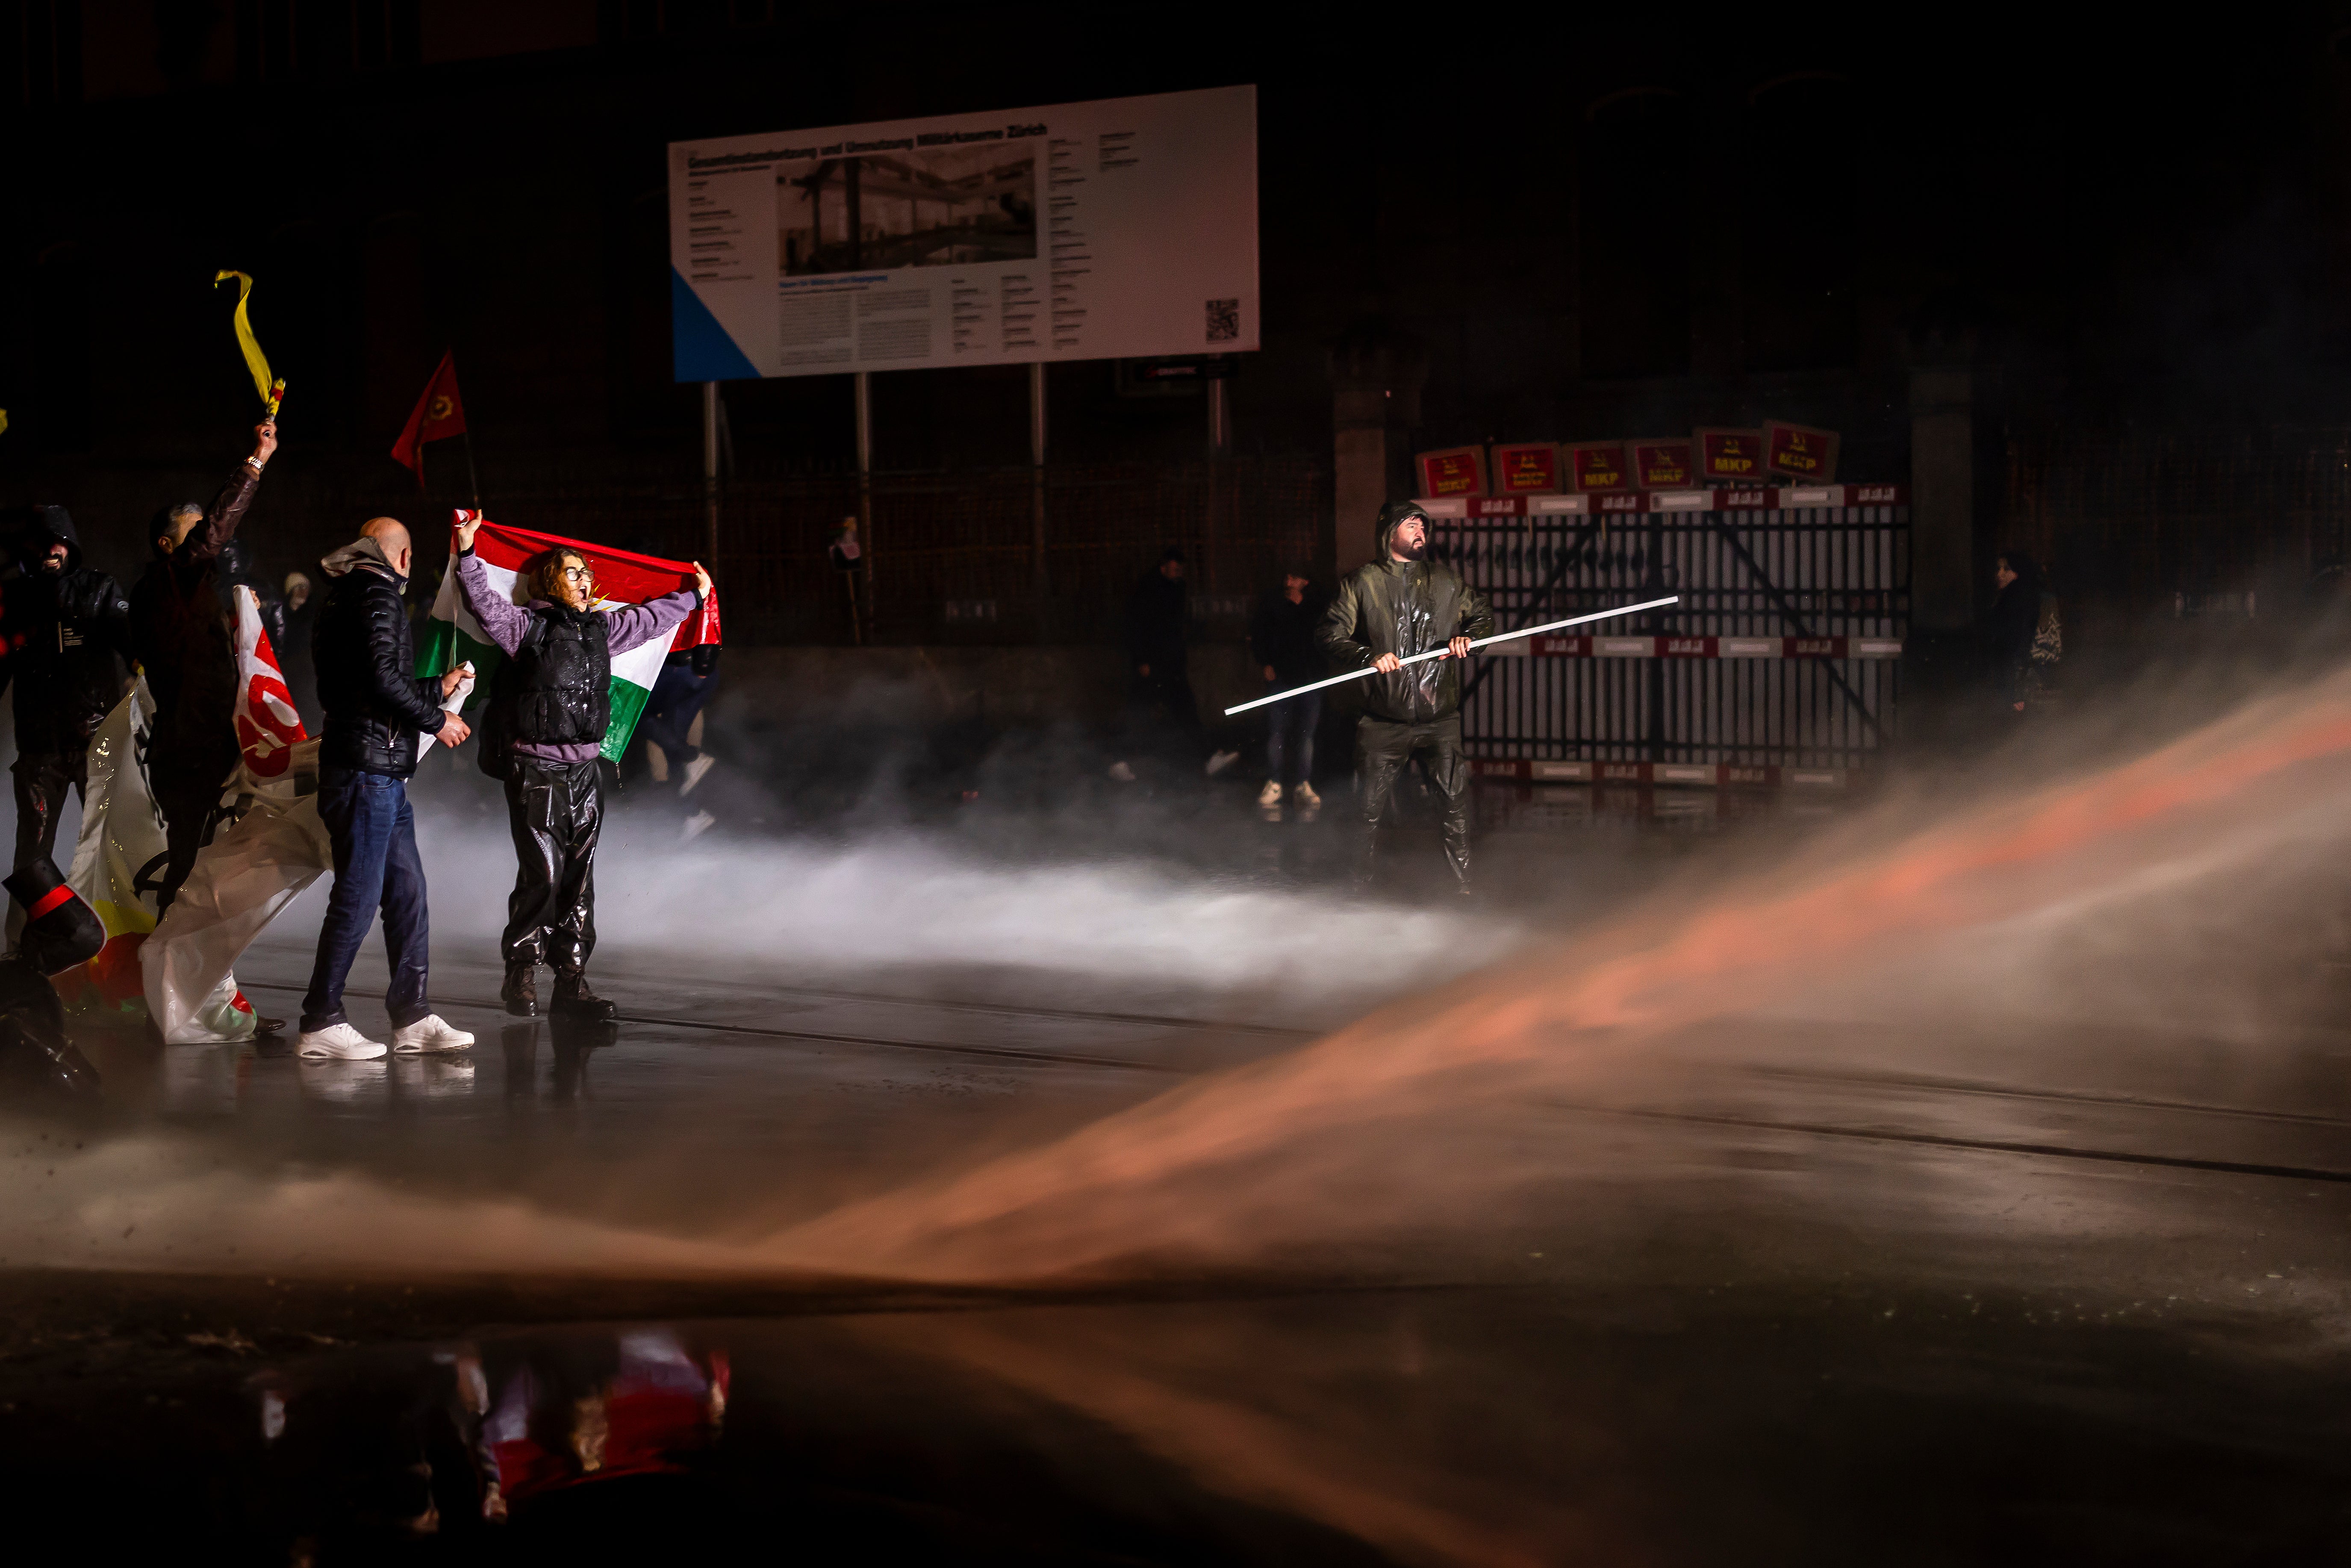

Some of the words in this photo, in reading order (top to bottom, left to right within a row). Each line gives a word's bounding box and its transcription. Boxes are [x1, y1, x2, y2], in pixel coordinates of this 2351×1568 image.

[821, 143, 843, 155] und
[1008, 123, 1048, 138] Zürich
[1715, 457, 1753, 472] MKP
[1584, 472, 1619, 486] MKP
